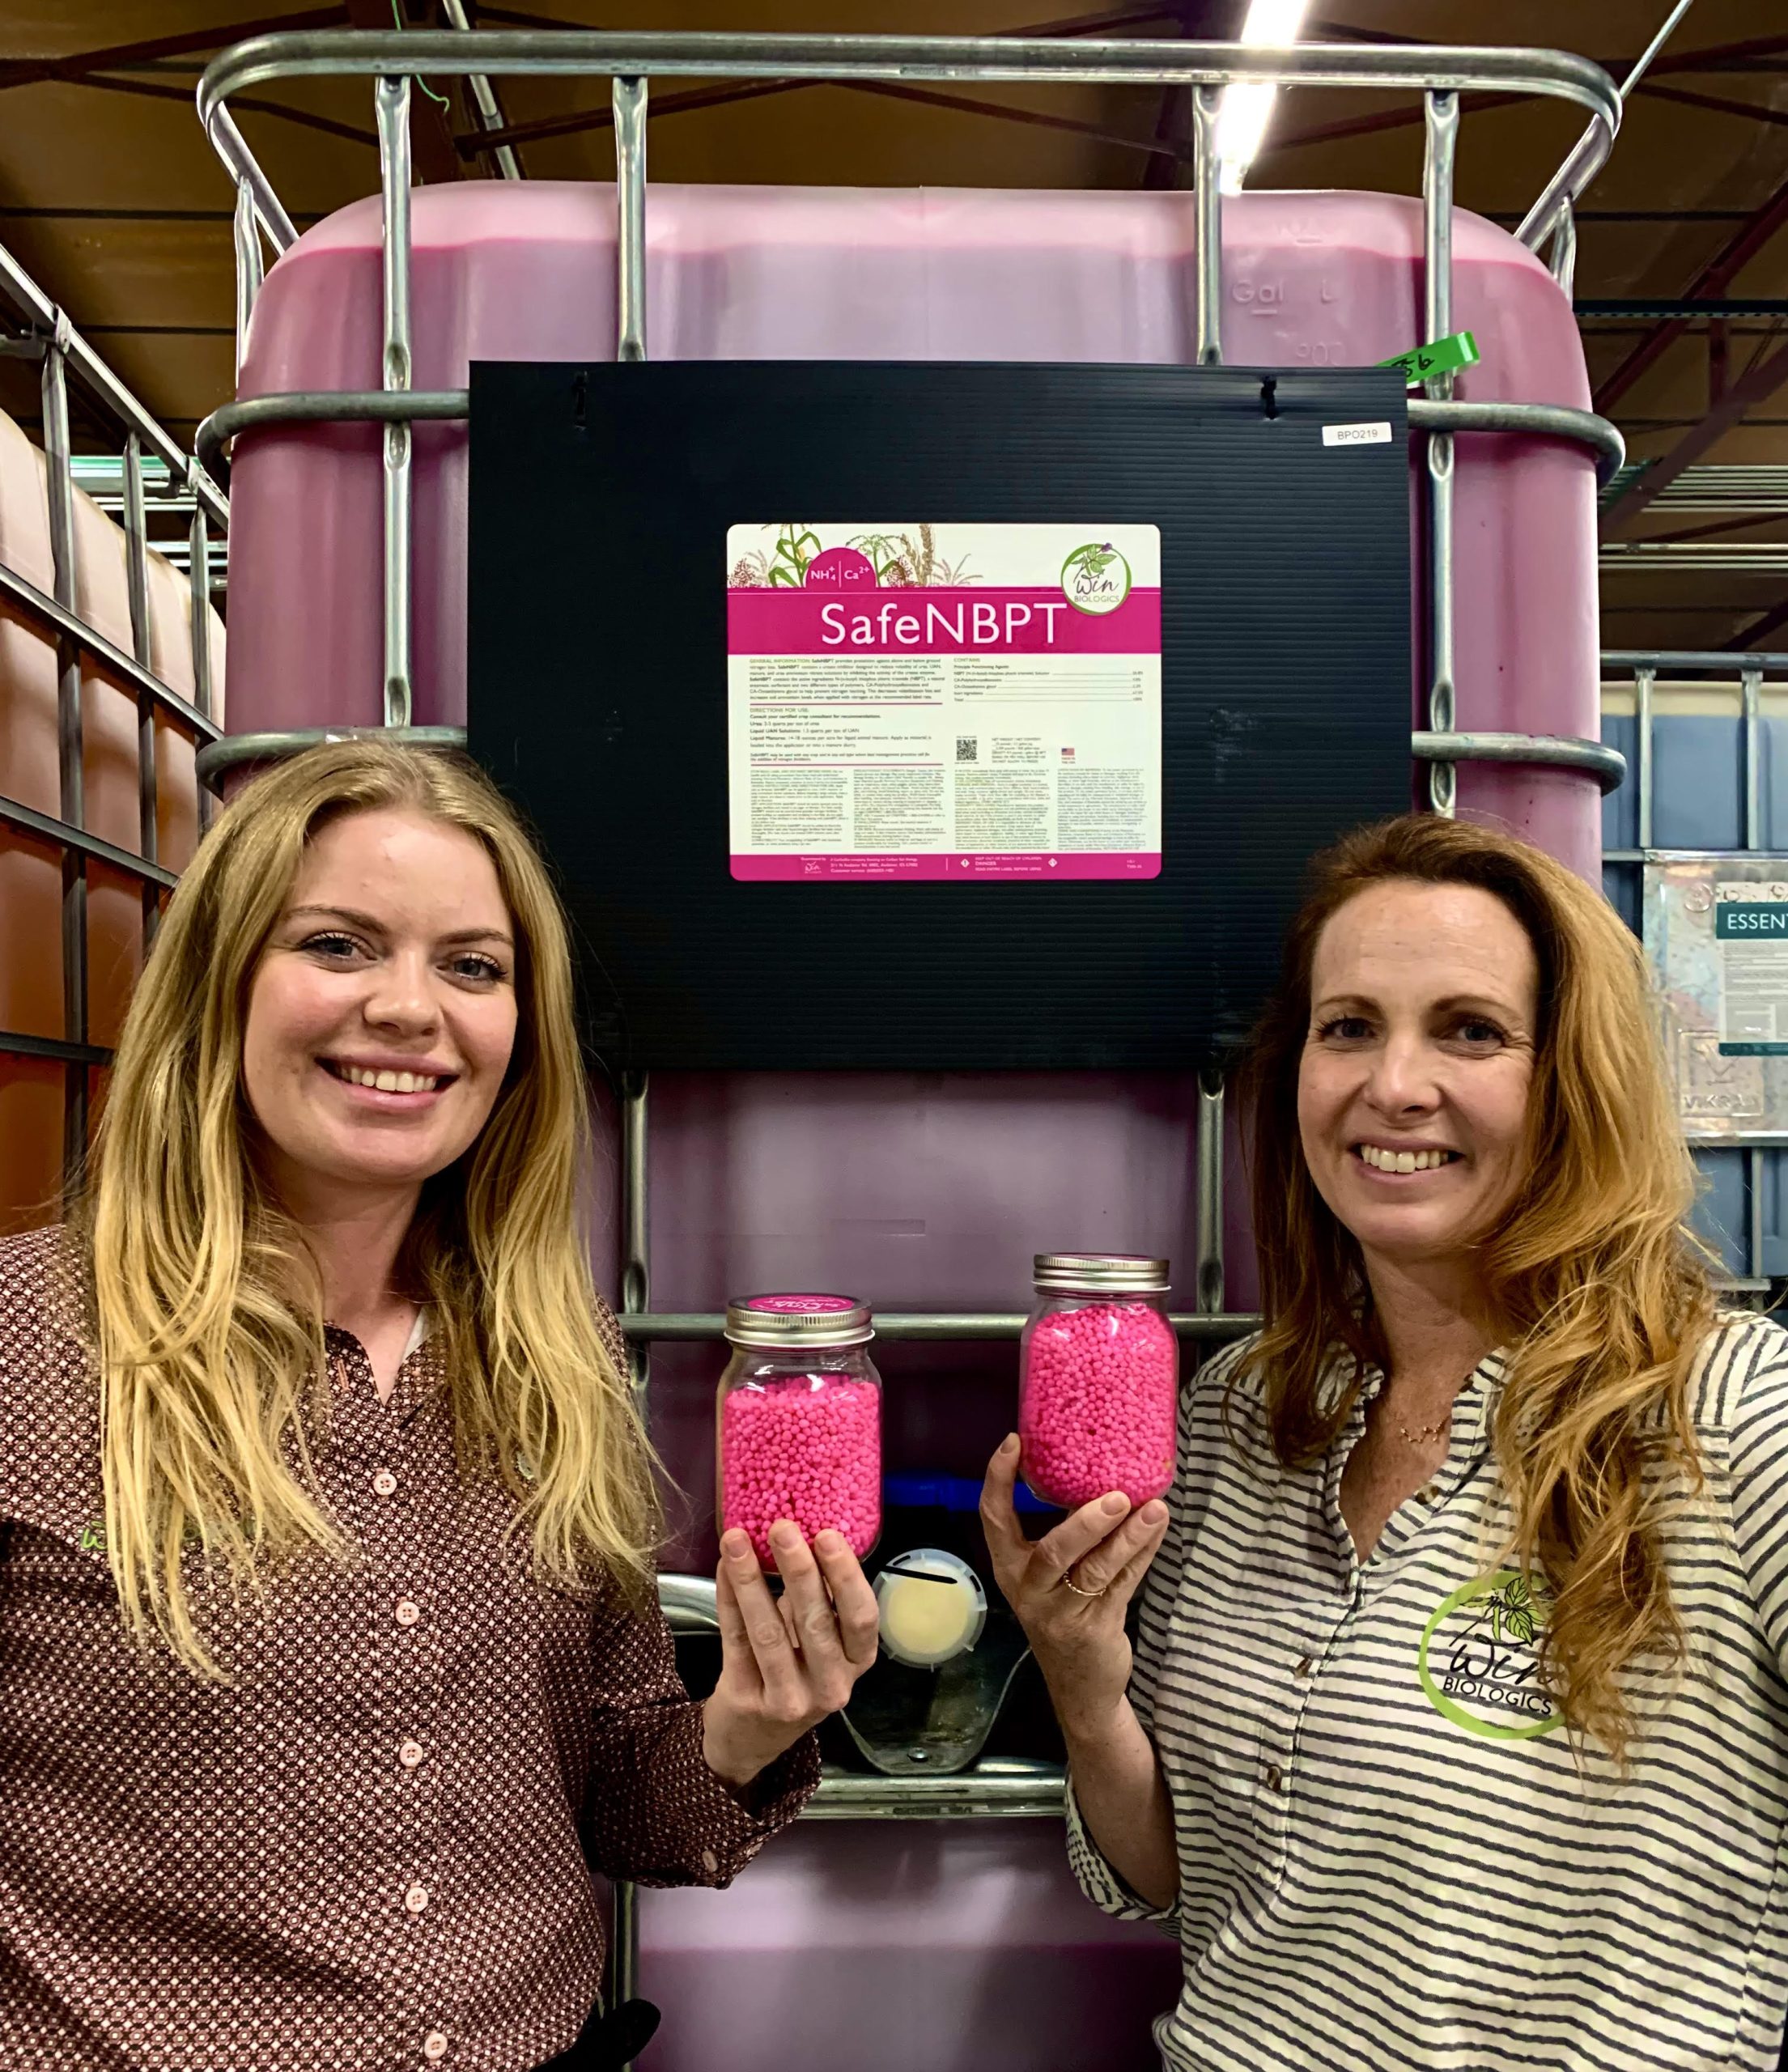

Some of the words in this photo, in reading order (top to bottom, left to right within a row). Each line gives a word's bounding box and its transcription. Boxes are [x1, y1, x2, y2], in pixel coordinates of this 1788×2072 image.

[1232, 279, 1285, 304] Gal
[1074, 569, 1119, 595] Win
[1074, 595, 1119, 603] BIOLOGICS
[821, 601, 1068, 644] SafeNBPT
[1727, 913, 1788, 930] ESSEN
[1442, 1676, 1553, 1716] BIOLOGICS
